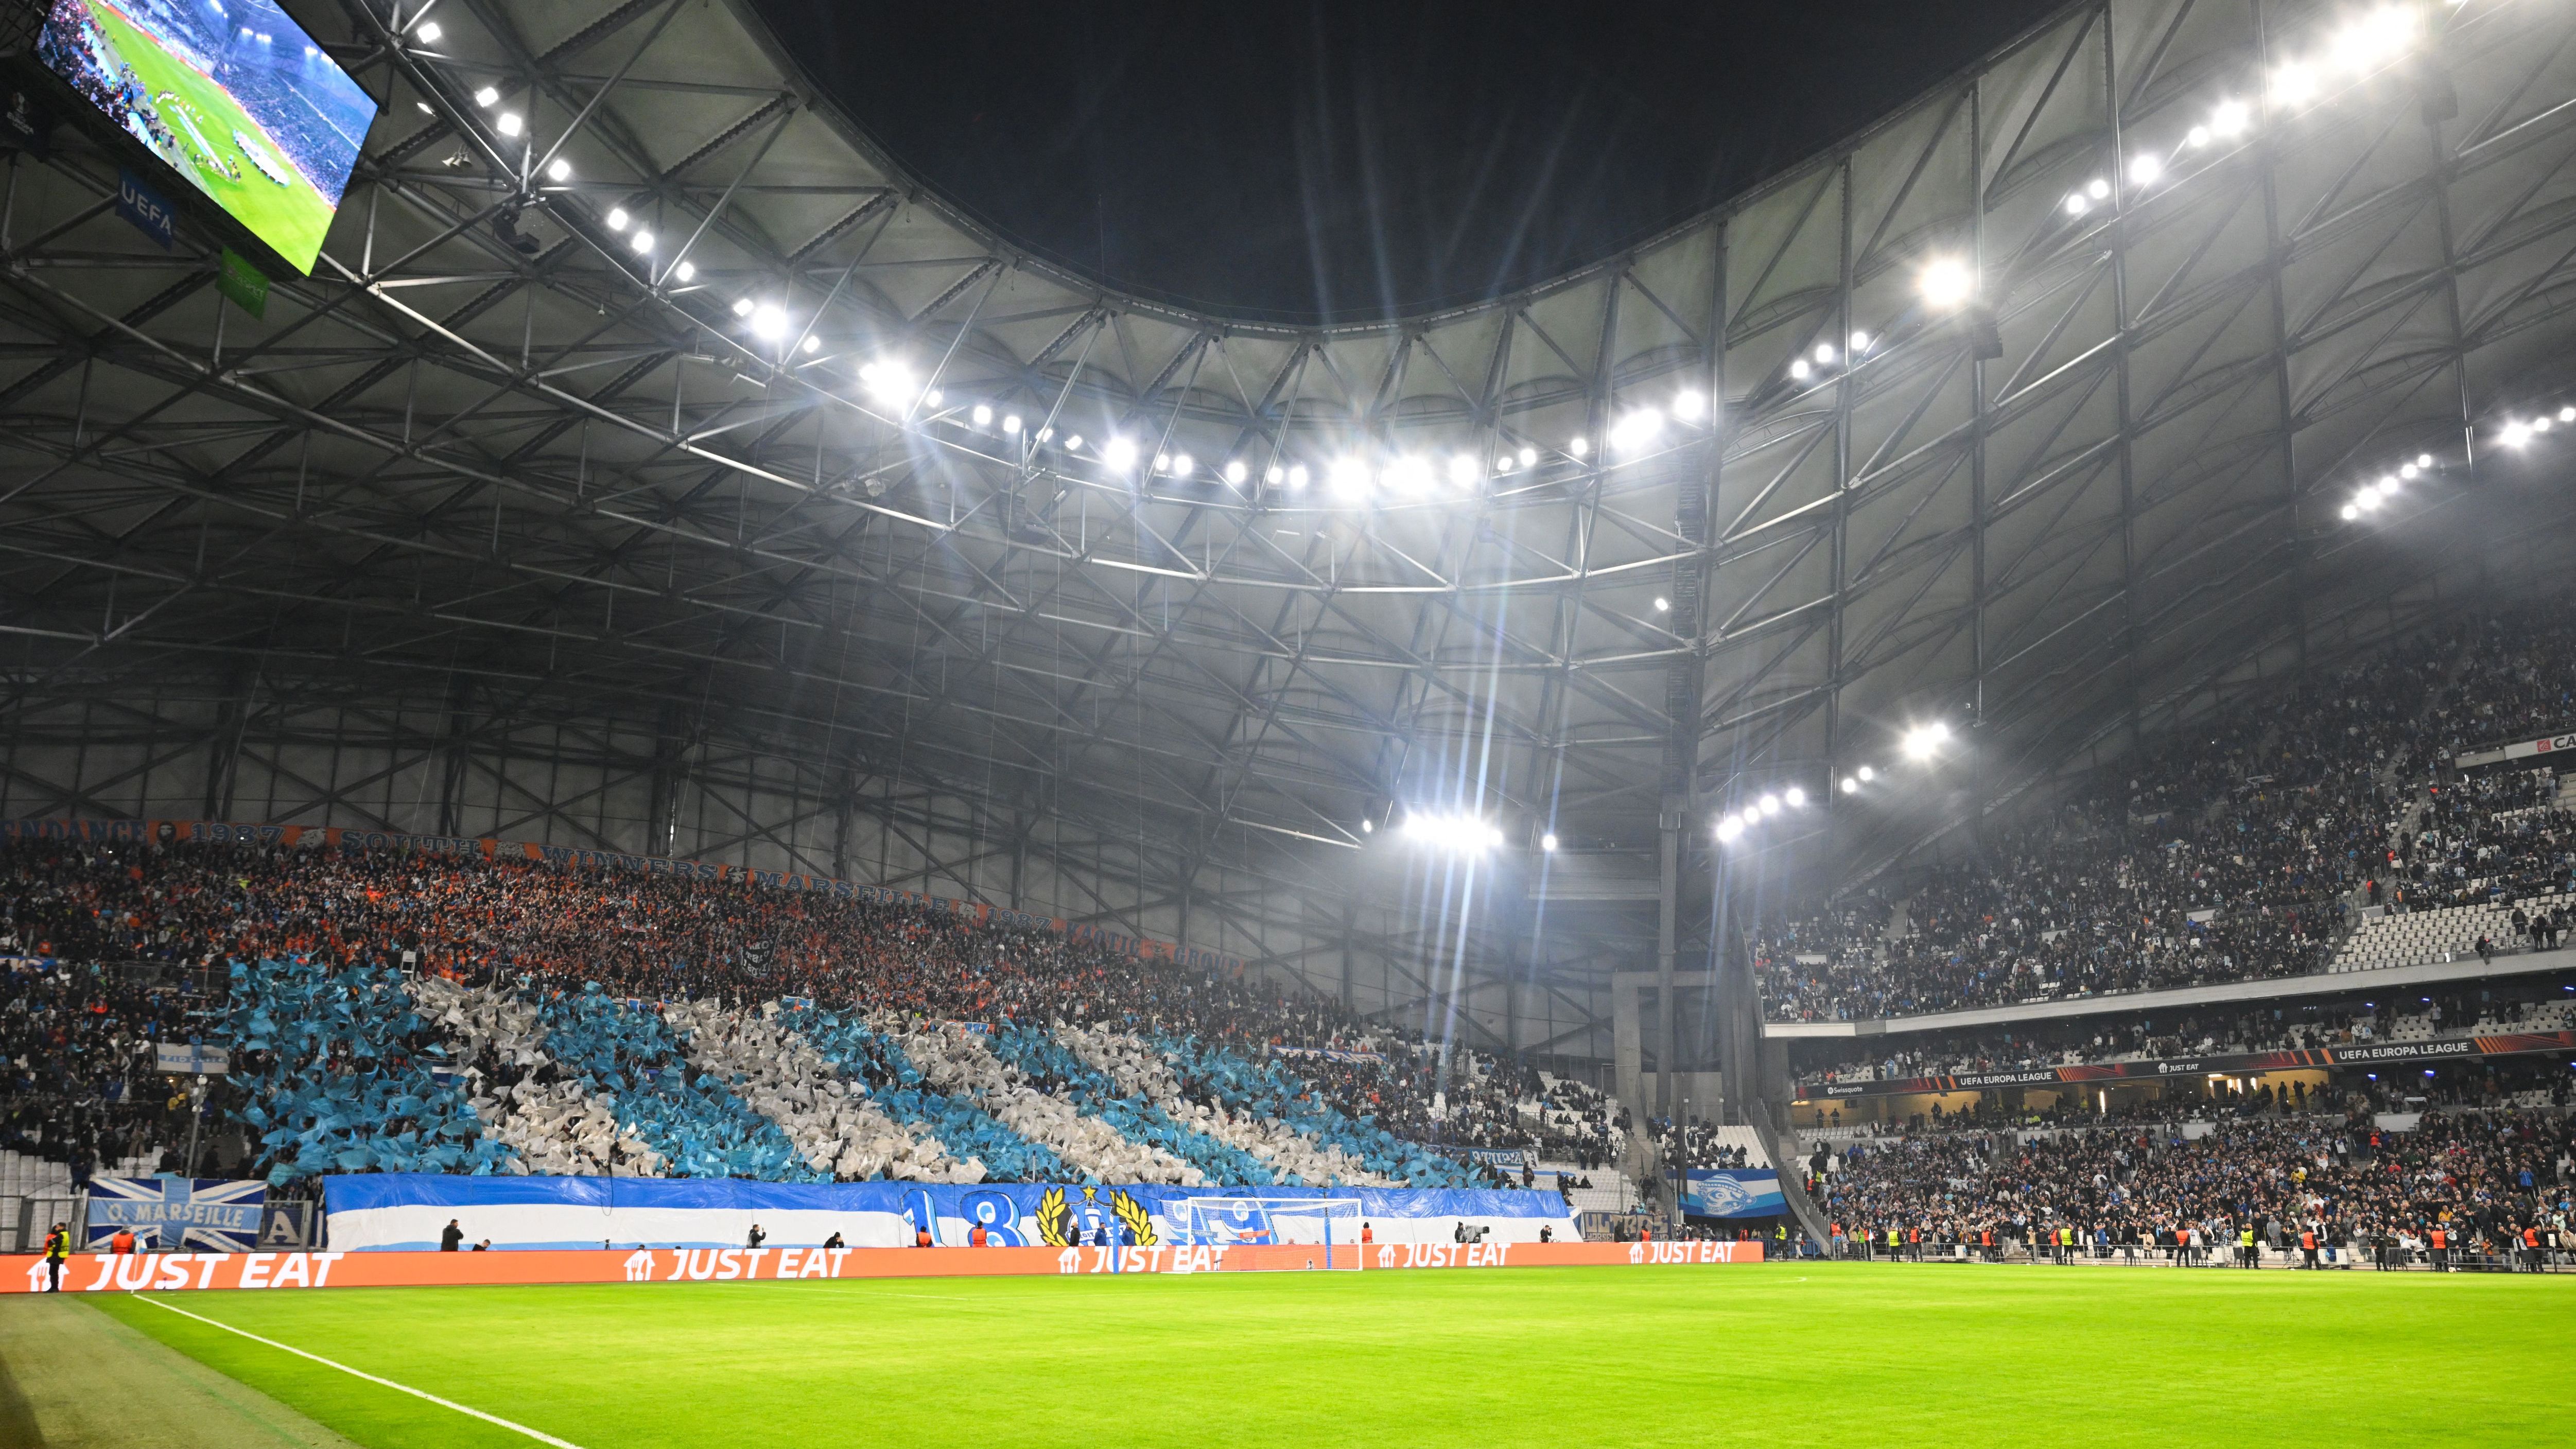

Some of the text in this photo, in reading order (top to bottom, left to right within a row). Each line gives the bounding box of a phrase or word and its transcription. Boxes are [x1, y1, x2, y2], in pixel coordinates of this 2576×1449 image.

[121, 180, 171, 236] UEFA
[191, 823, 285, 847] 1987
[340, 831, 481, 858] SOUTH
[539, 845, 719, 881] WINNERS
[754, 869, 951, 913] MARSEILLE
[987, 906, 1053, 932] 1987
[1174, 945, 1241, 975] GROUP
[2339, 1042, 2468, 1060] UEFA EUROPA LEAGUE
[1960, 1072, 2052, 1085] UEFA EUROPA LEAGUE
[135, 1202, 245, 1227] MARSEILLE
[667, 1248, 852, 1281] JUST EAT
[1090, 1245, 1229, 1273] JUST EAT
[1403, 1243, 1511, 1268] JUST EAT
[1649, 1242, 1736, 1264] JUST EAT
[86, 1252, 343, 1290] JUST EAT
